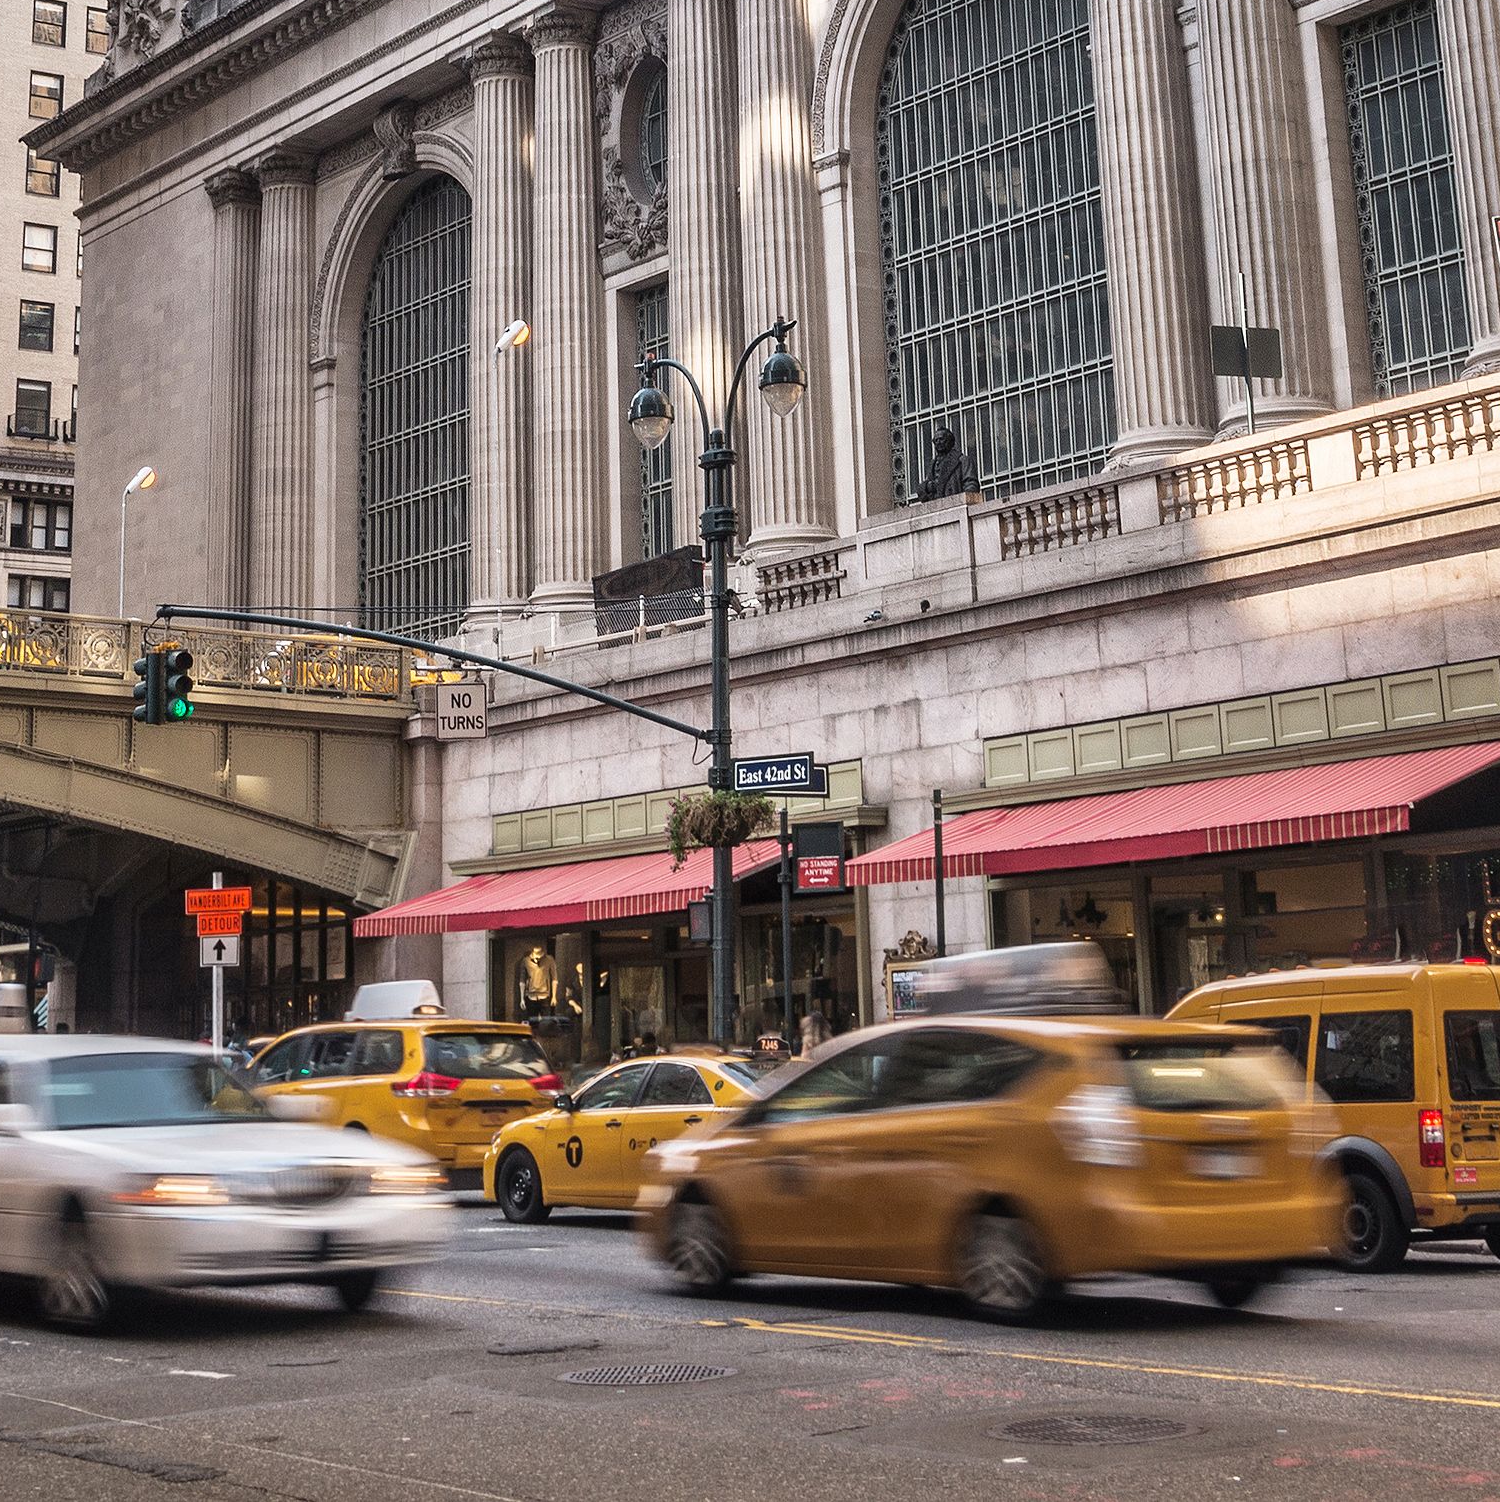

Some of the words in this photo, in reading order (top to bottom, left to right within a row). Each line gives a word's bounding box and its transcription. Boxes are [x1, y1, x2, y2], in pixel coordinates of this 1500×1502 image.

[451, 693, 472, 709] NO
[439, 715, 484, 730] TURNS
[738, 768, 762, 784] East
[764, 765, 791, 782] 42nd
[794, 763, 806, 780] St
[800, 860, 809, 868] NO
[810, 859, 838, 868] STANDING
[804, 868, 834, 876] ANYTIME
[189, 894, 231, 909] VANDERBILT
[233, 893, 245, 906] AVE
[201, 916, 240, 931] DETOUR
